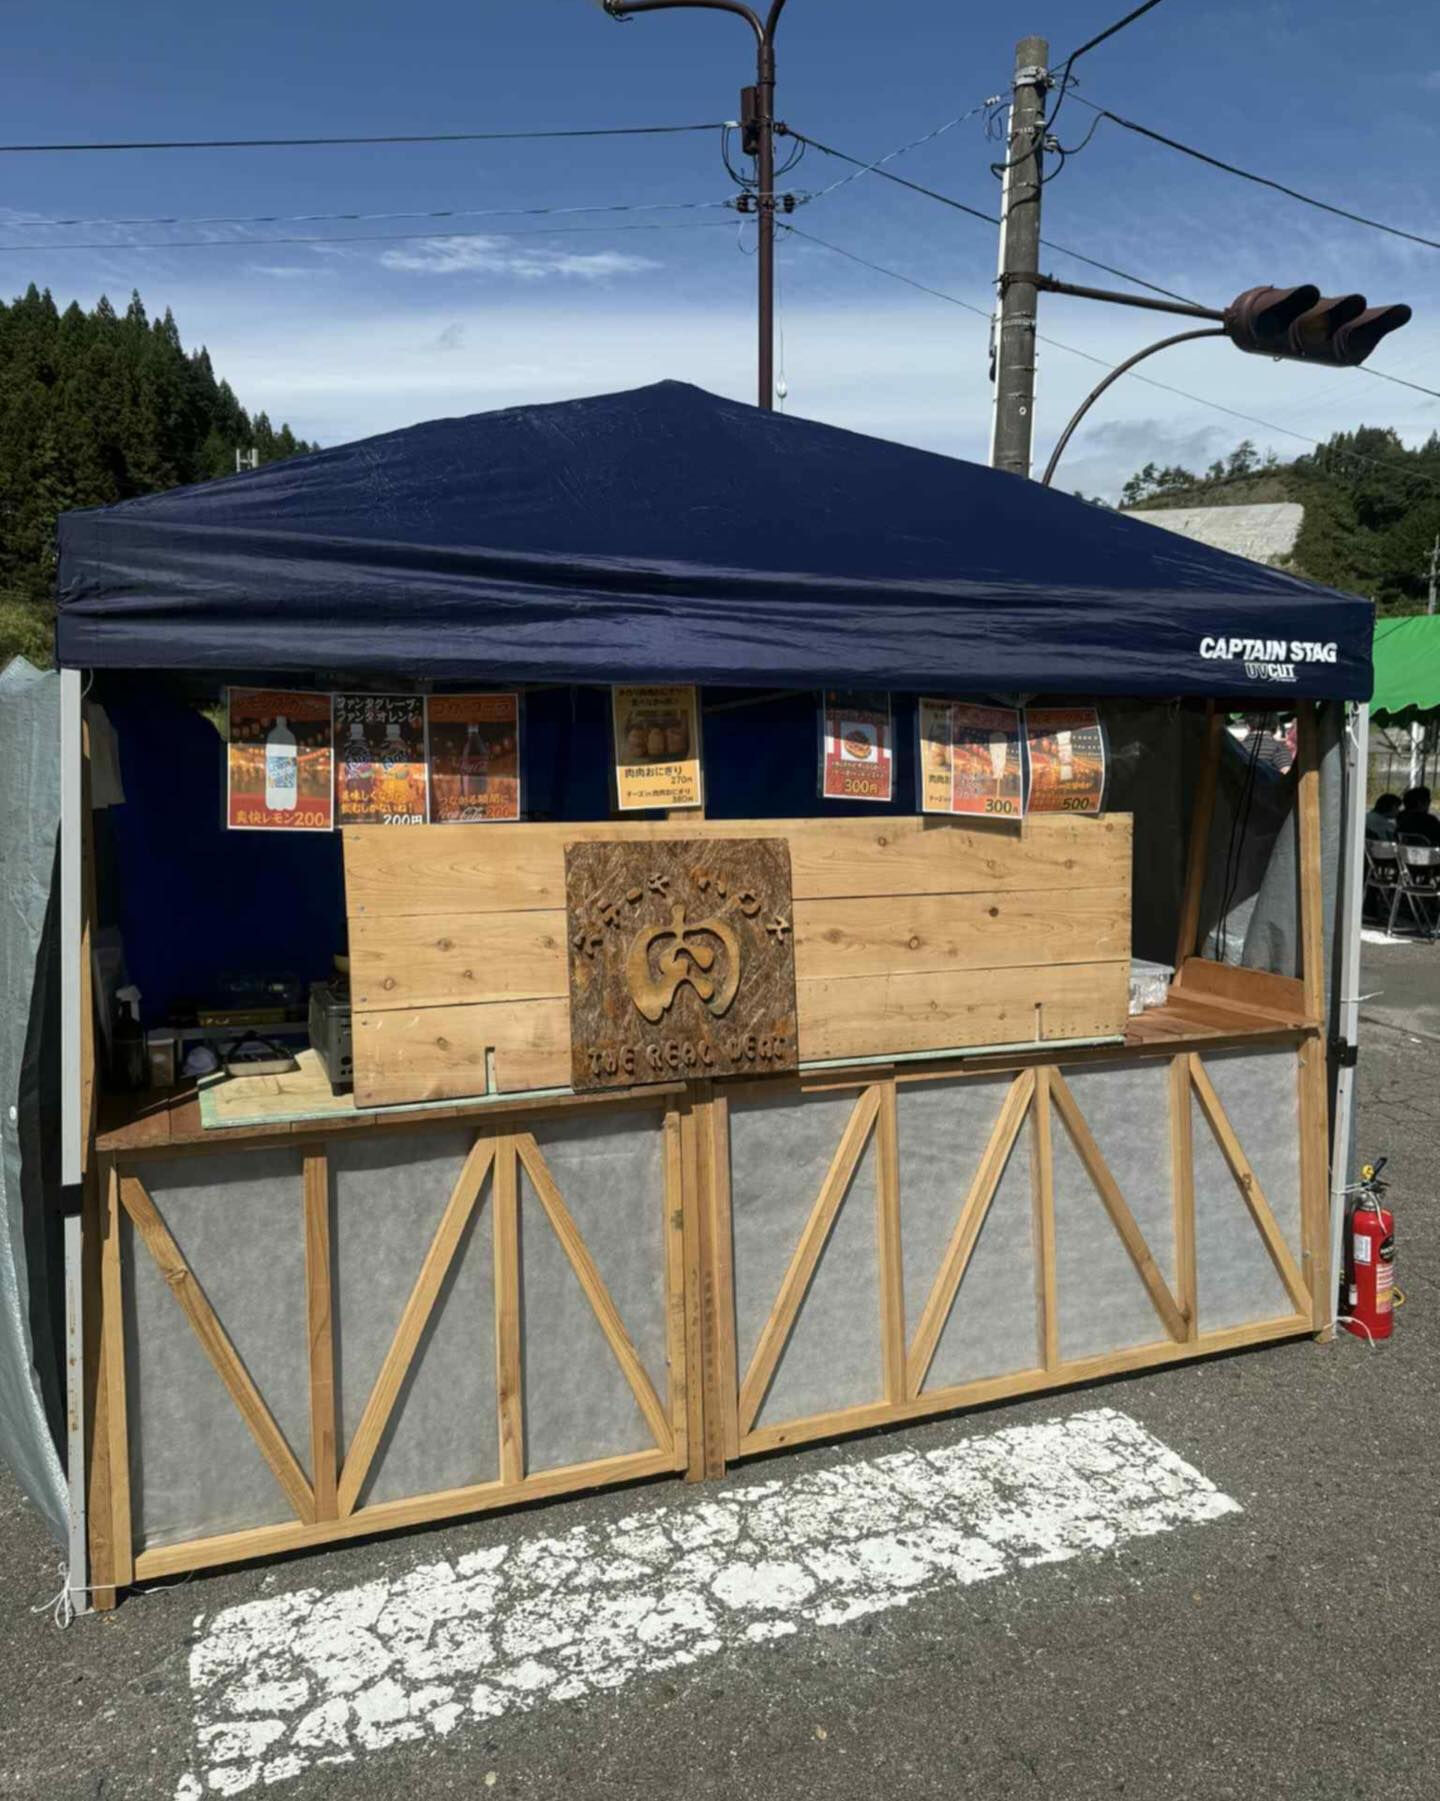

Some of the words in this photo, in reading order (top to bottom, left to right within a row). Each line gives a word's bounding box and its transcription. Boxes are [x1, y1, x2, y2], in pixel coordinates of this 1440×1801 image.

[1200, 637, 1287, 661] CAPTAIN
[1290, 641, 1338, 663] STAG
[587, 1045, 636, 1077] THE
[645, 1039, 714, 1072] REAL
